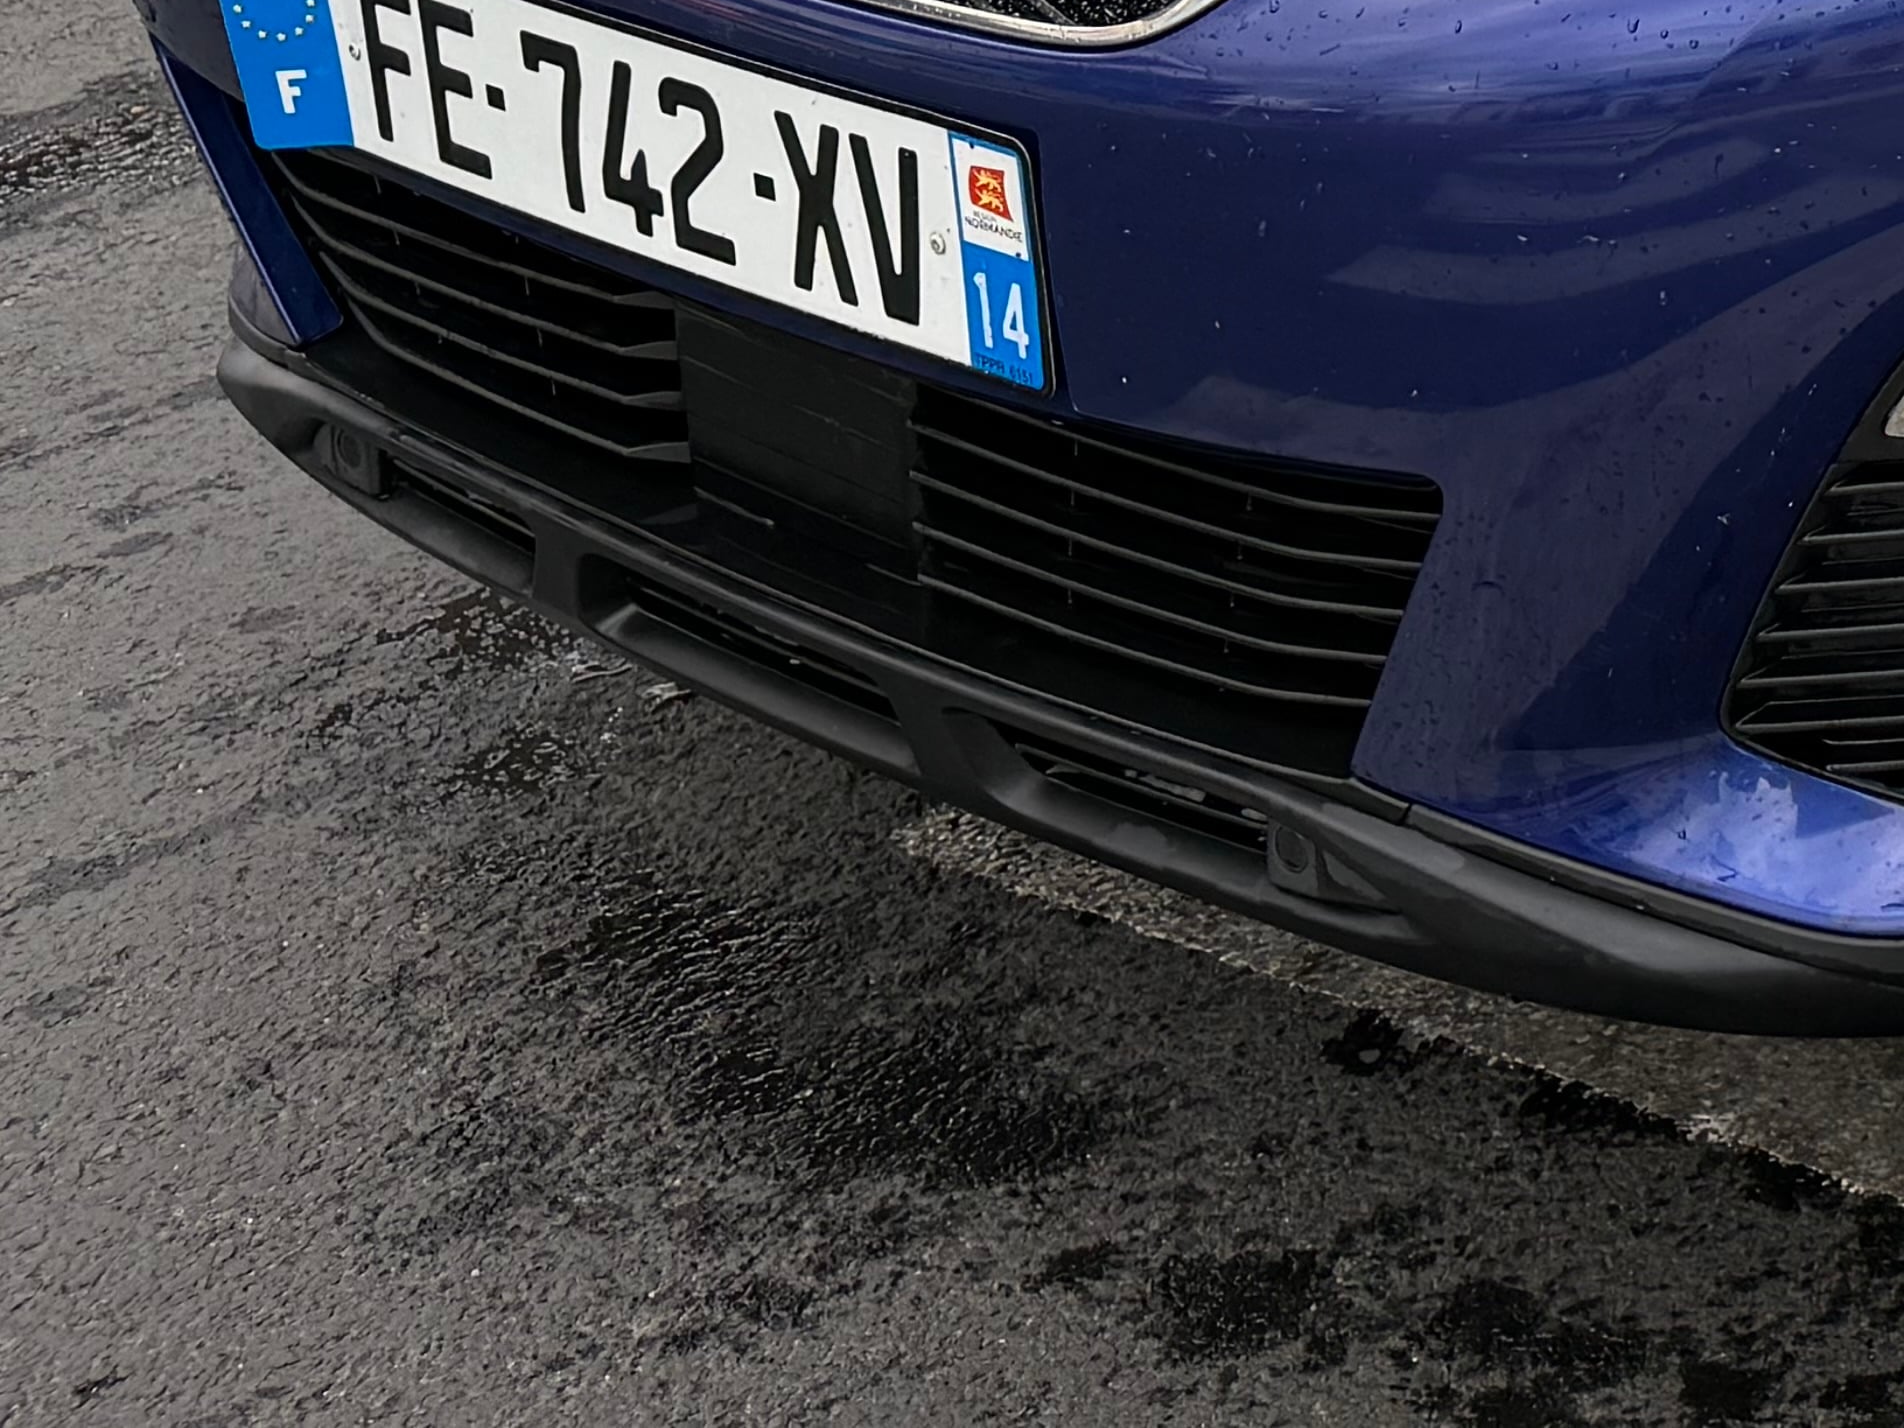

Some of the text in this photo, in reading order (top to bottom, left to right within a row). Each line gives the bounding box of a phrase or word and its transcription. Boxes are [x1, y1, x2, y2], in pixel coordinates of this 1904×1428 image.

[274, 67, 308, 116] F
[965, 216, 1023, 244] NORMANDIE
[973, 271, 1030, 360] 14
